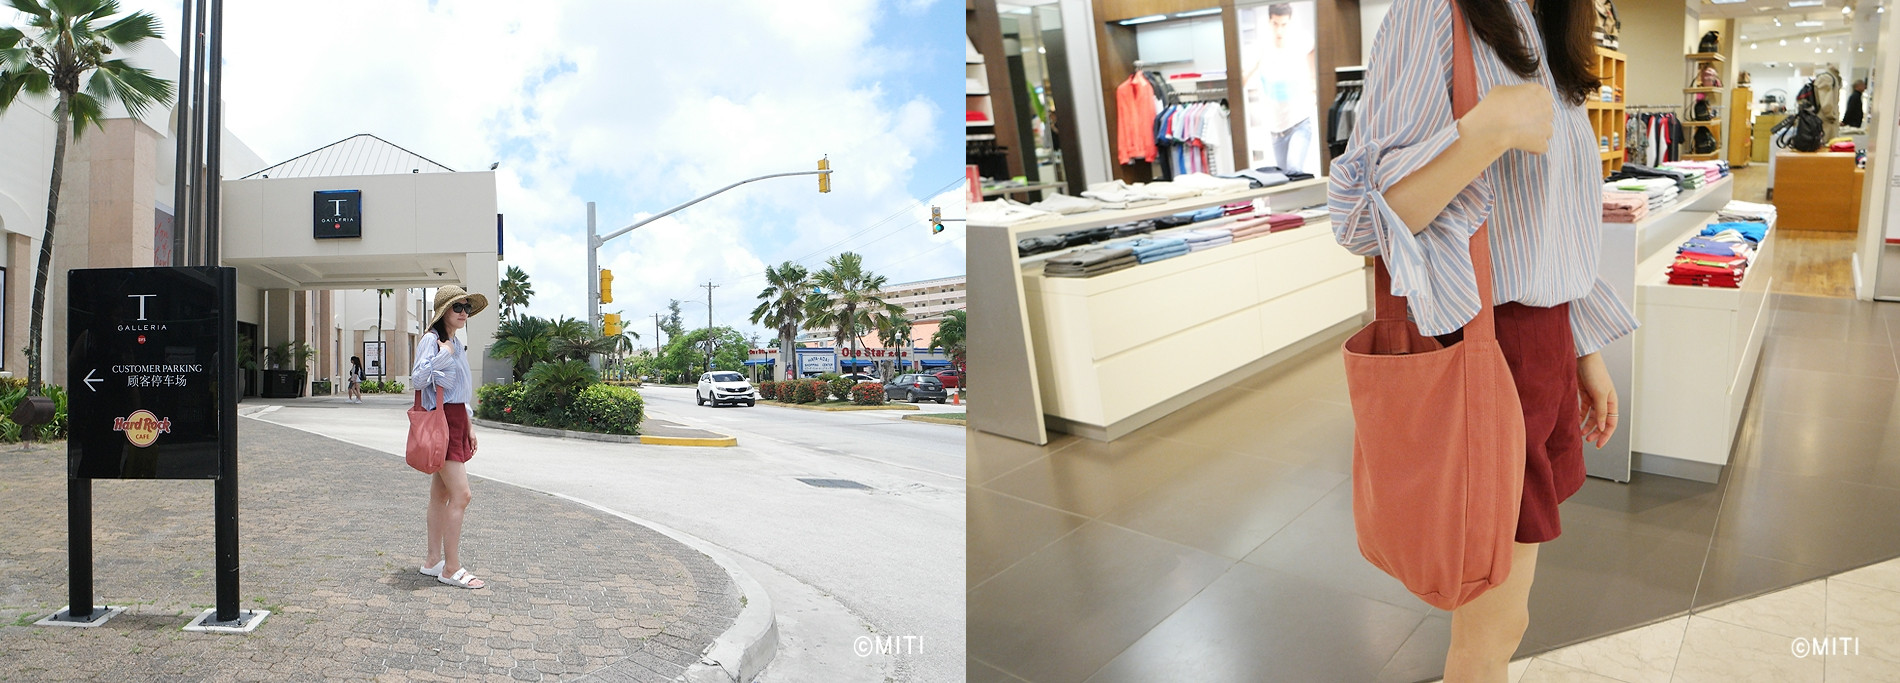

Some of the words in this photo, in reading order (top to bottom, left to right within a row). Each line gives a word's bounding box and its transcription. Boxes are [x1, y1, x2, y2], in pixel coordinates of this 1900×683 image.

[328, 199, 347, 216] T
[128, 294, 157, 321] T
[117, 324, 167, 332] GALLERIA
[864, 347, 886, 357] Star
[112, 364, 160, 373] CUSTOMER
[162, 364, 202, 373] PARKING
[127, 374, 187, 387] 顾客停车场
[113, 416, 142, 431] Hard
[143, 417, 171, 434] Rock
